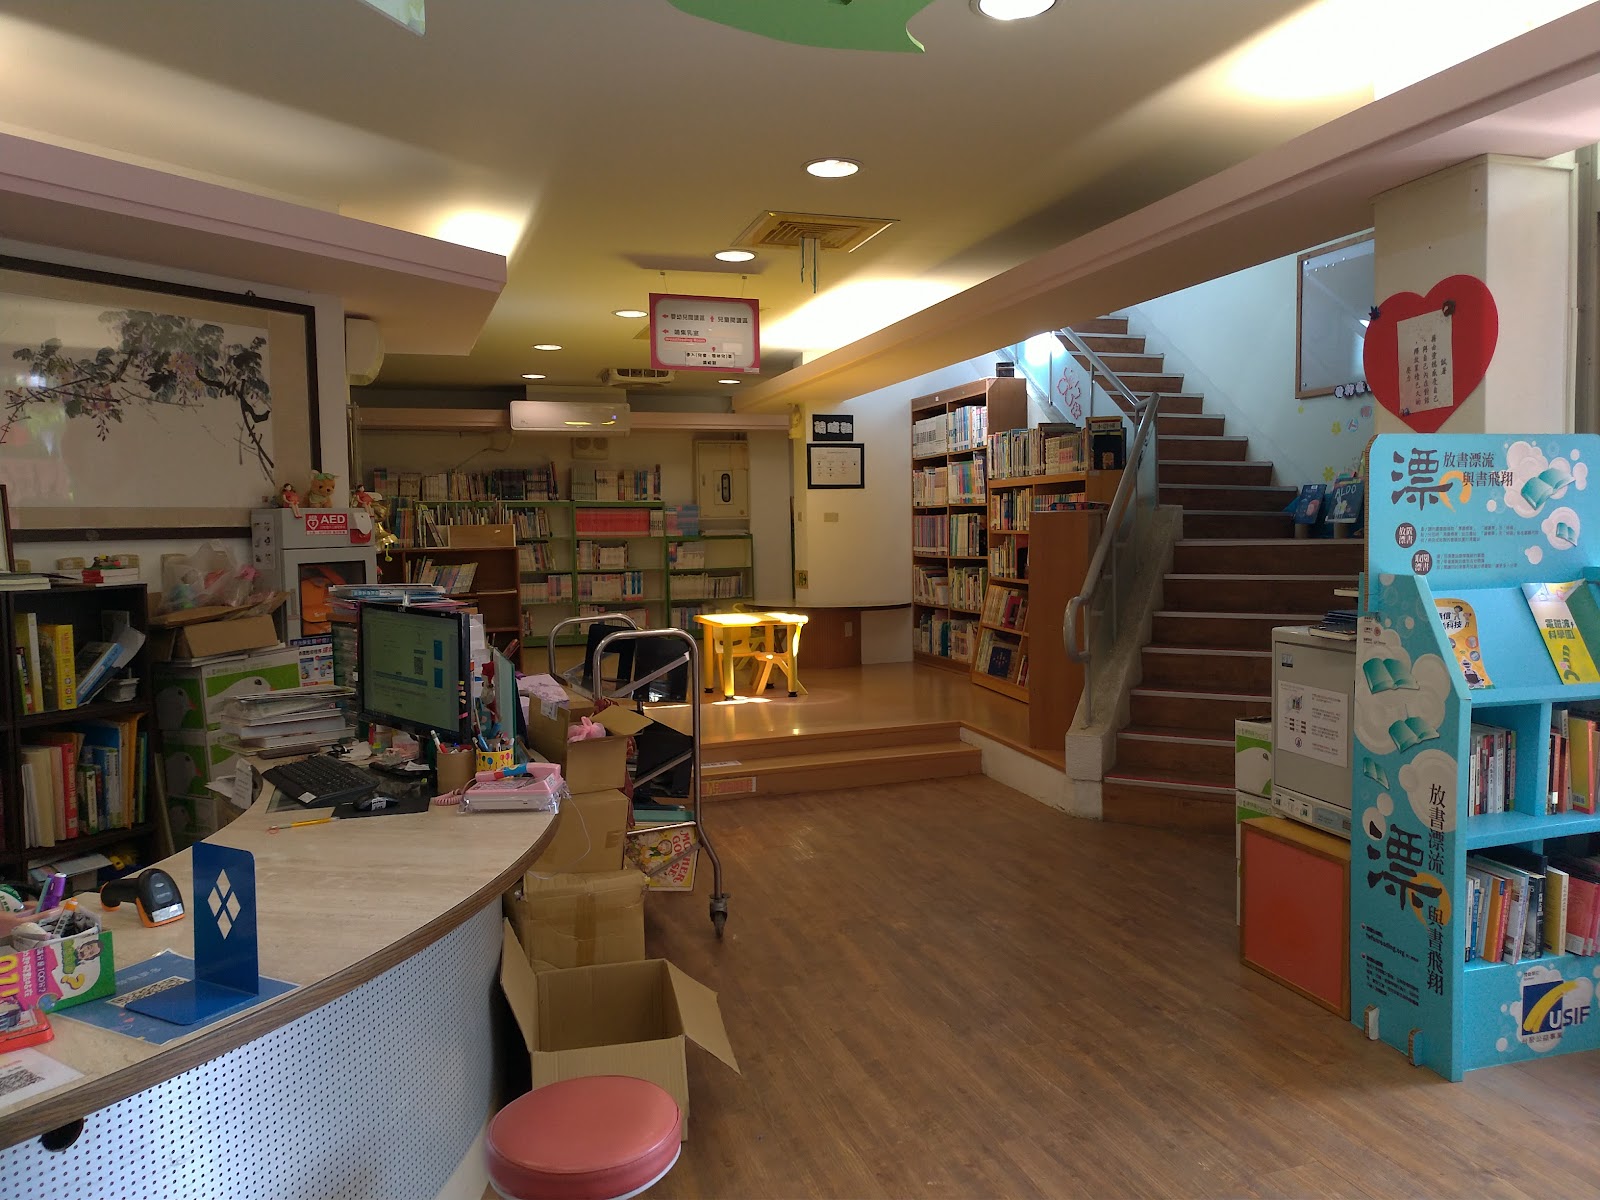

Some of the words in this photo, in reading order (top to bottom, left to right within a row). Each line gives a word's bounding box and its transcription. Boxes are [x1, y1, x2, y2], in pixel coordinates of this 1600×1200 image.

[1391, 447, 1453, 511] 漂
[1442, 452, 1495, 468] 放書漂流
[1462, 470, 1513, 487] 與書飛翔
[1335, 485, 1357, 499] ALDO
[320, 514, 346, 524] AED
[1428, 783, 1446, 876] 放書漂流
[672, 831, 693, 883] MOHER
[1367, 820, 1443, 911] 漂
[1427, 905, 1444, 997] 與書飛翔
[1549, 1005, 1591, 1029] USIF
